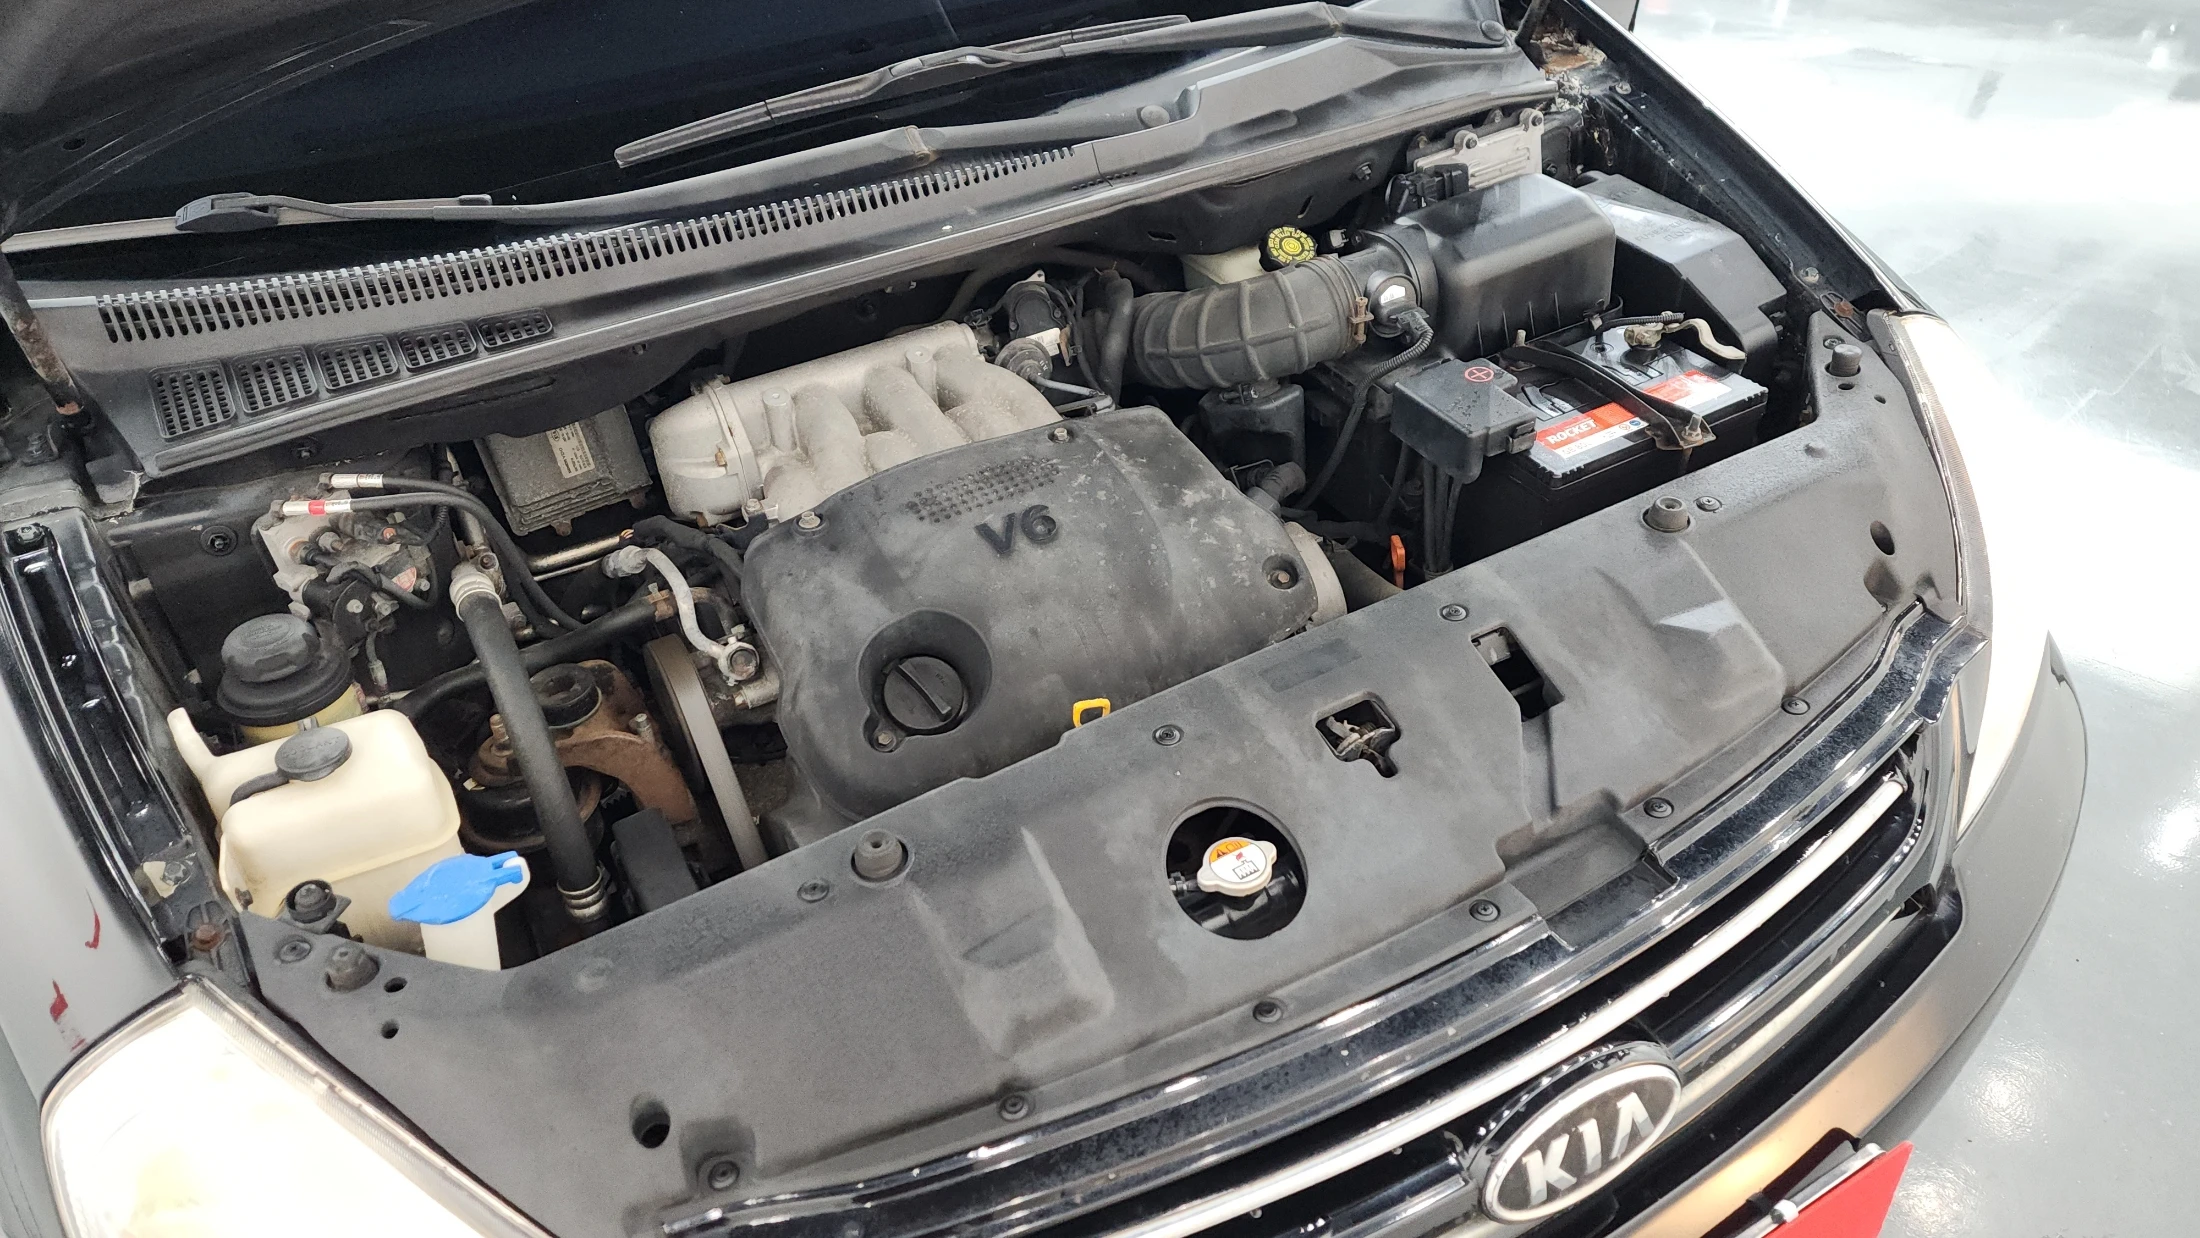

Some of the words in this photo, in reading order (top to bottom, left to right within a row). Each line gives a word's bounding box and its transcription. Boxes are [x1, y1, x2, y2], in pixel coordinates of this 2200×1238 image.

[1546, 419, 1597, 444] ROCKET
[974, 504, 1057, 555] V6
[1521, 1091, 1655, 1208] KIA
